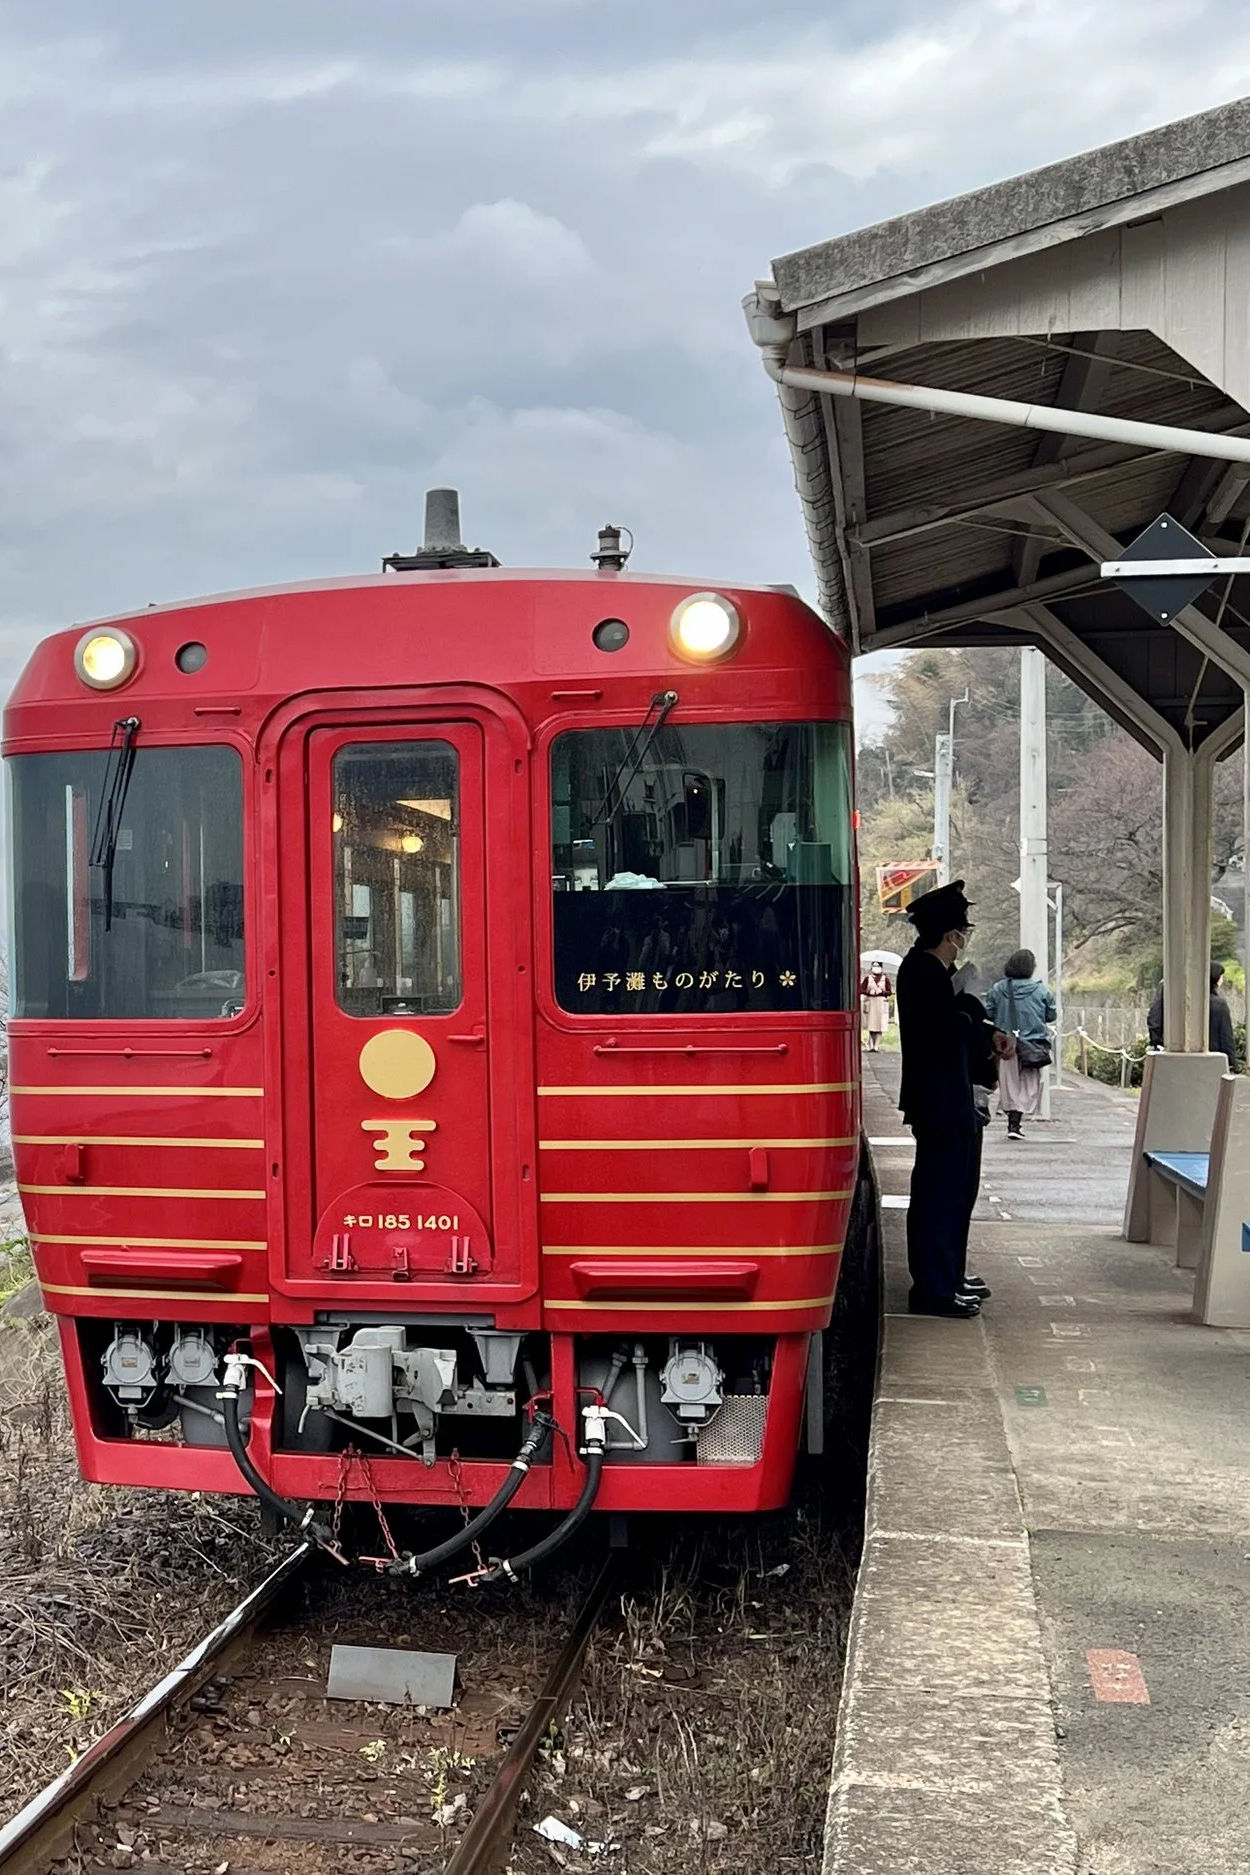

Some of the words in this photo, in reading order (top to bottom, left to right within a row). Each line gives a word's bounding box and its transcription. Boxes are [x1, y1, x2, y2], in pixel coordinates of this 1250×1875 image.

[577, 970, 764, 991] 伊予灘ものがたり
[378, 1214, 410, 1230] 185
[417, 1215, 458, 1230] 1401
